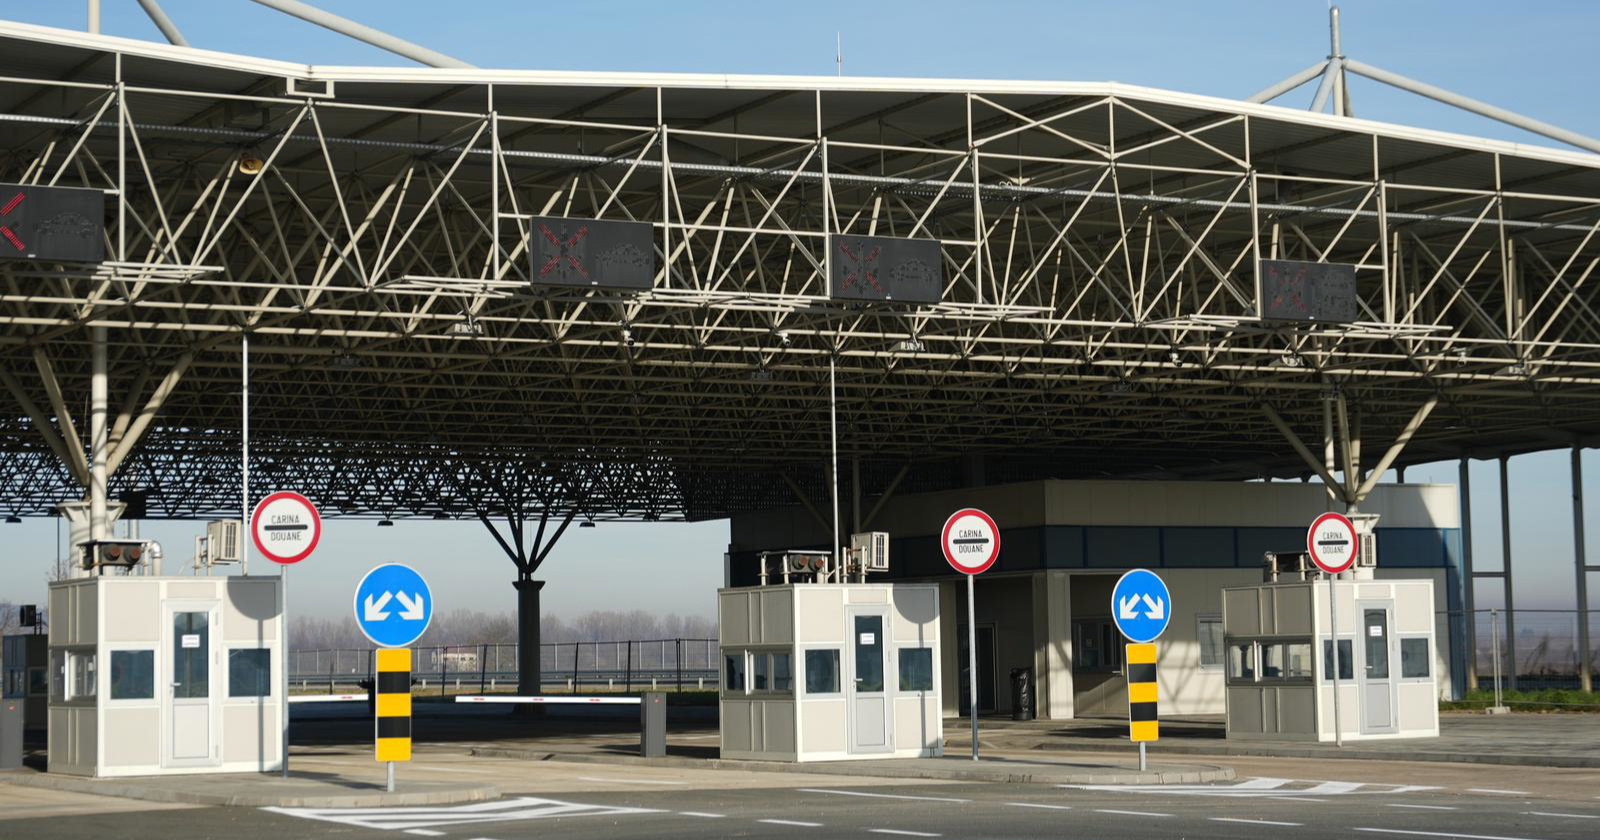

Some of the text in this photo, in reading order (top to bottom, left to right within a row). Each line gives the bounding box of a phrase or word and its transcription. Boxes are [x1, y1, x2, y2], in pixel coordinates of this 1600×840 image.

[271, 515, 300, 524] CARINA
[270, 531, 302, 541] DOUANE
[959, 529, 982, 538] CARINA
[958, 544, 984, 553] DOUANE
[1323, 545, 1344, 554] DOUANE
